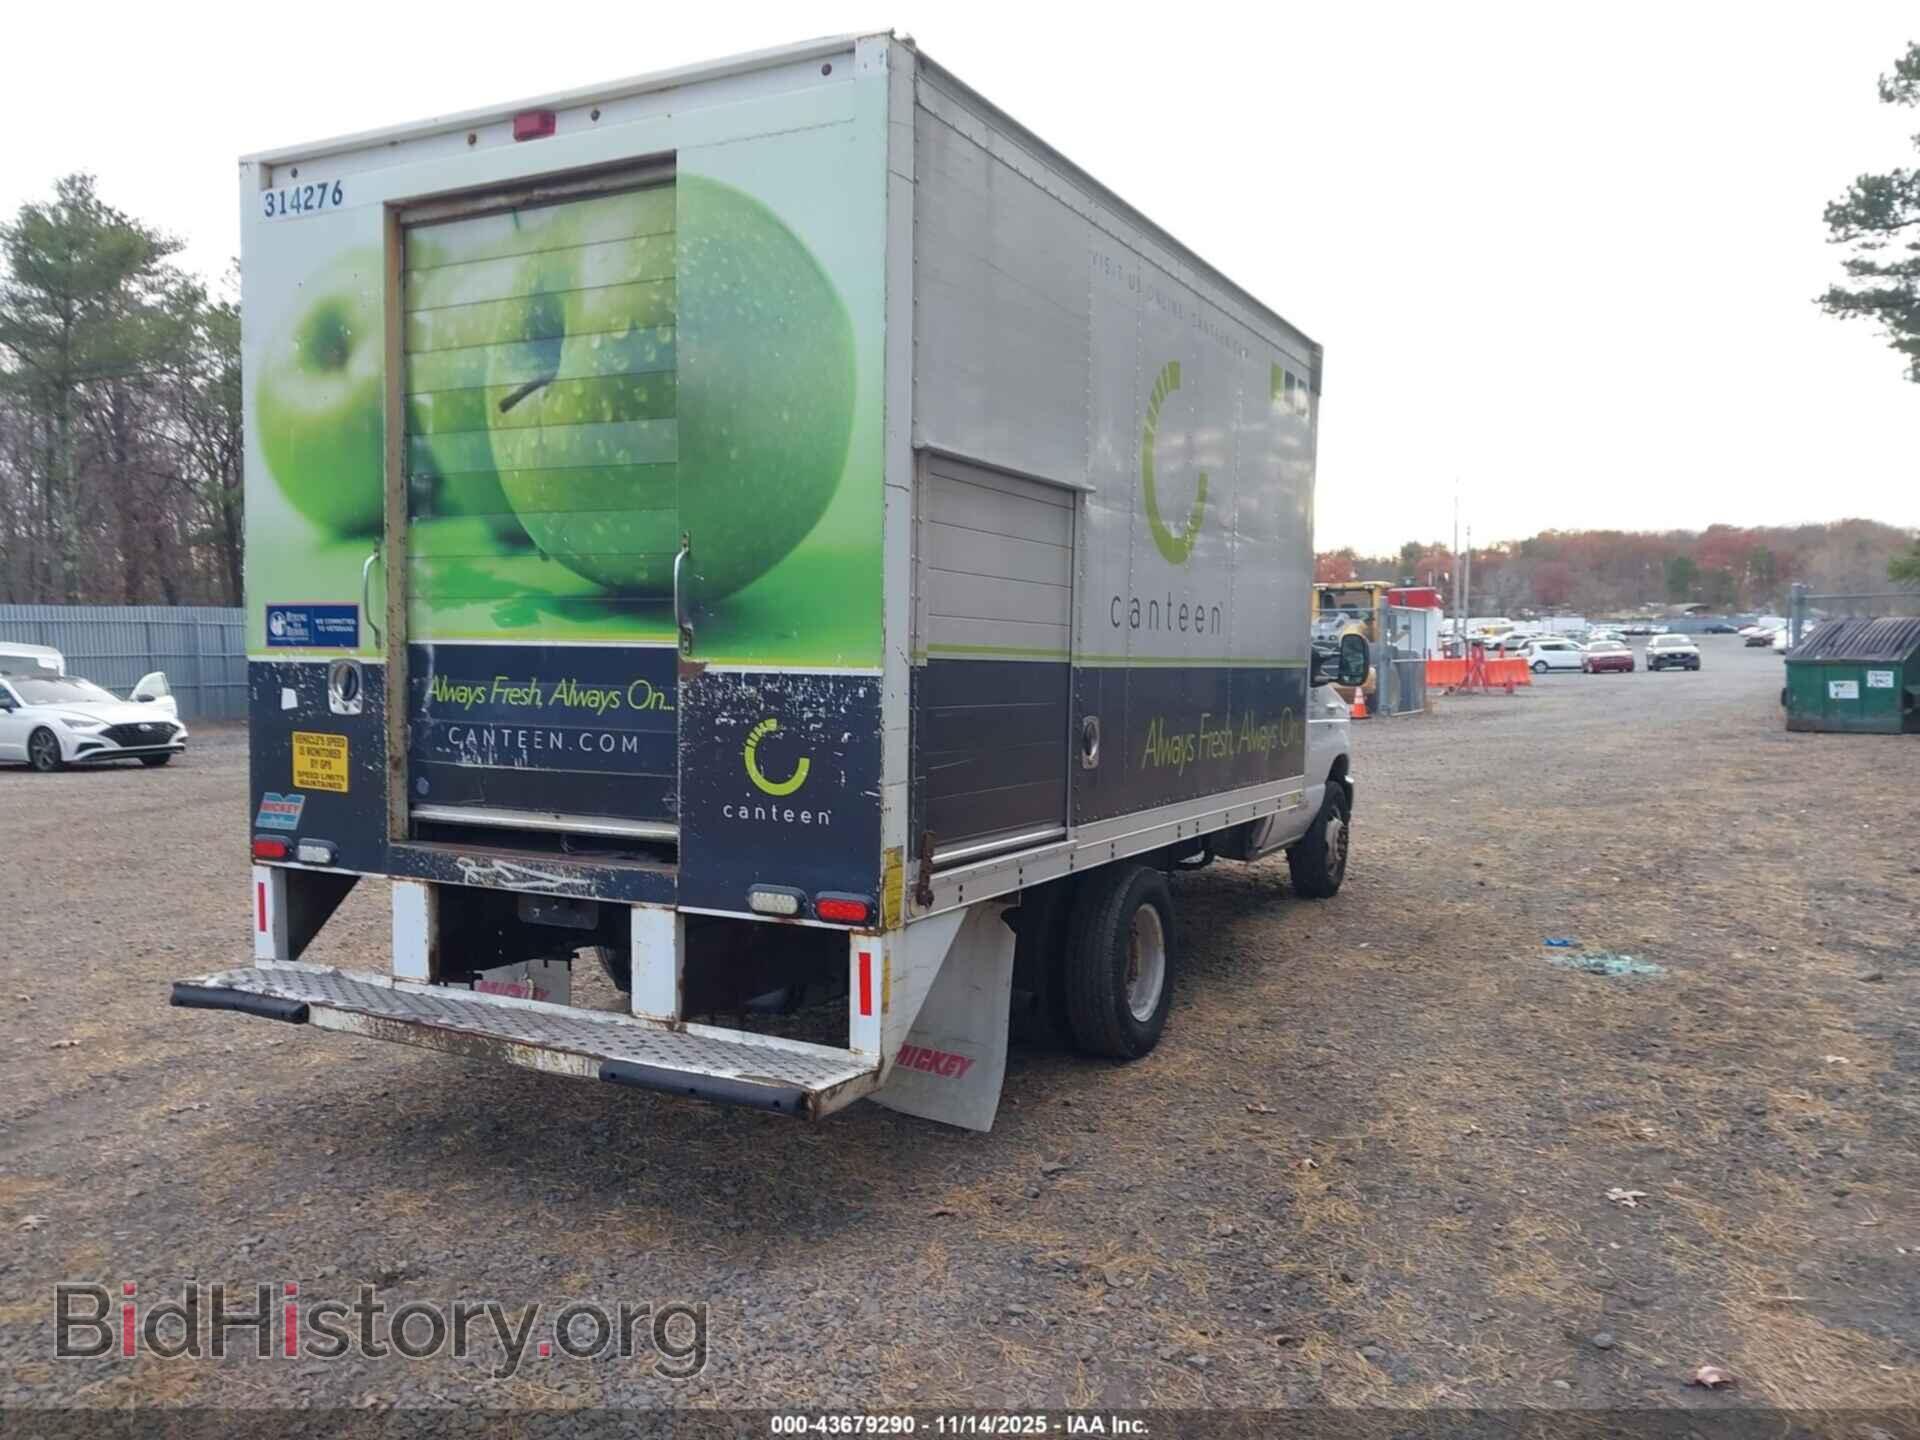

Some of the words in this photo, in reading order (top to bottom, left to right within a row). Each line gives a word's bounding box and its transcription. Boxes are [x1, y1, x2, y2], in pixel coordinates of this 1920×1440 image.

[264, 180, 343, 217] 314276
[1110, 591, 1221, 634] canteen
[429, 674, 487, 711] Always
[490, 676, 544, 709] Fresh,
[548, 677, 622, 716] Always
[628, 679, 675, 710] On...
[448, 726, 638, 753] CANTEEN.COM
[1141, 716, 1195, 777] Always
[1238, 709, 1279, 760] Always
[722, 804, 830, 825] canteen
